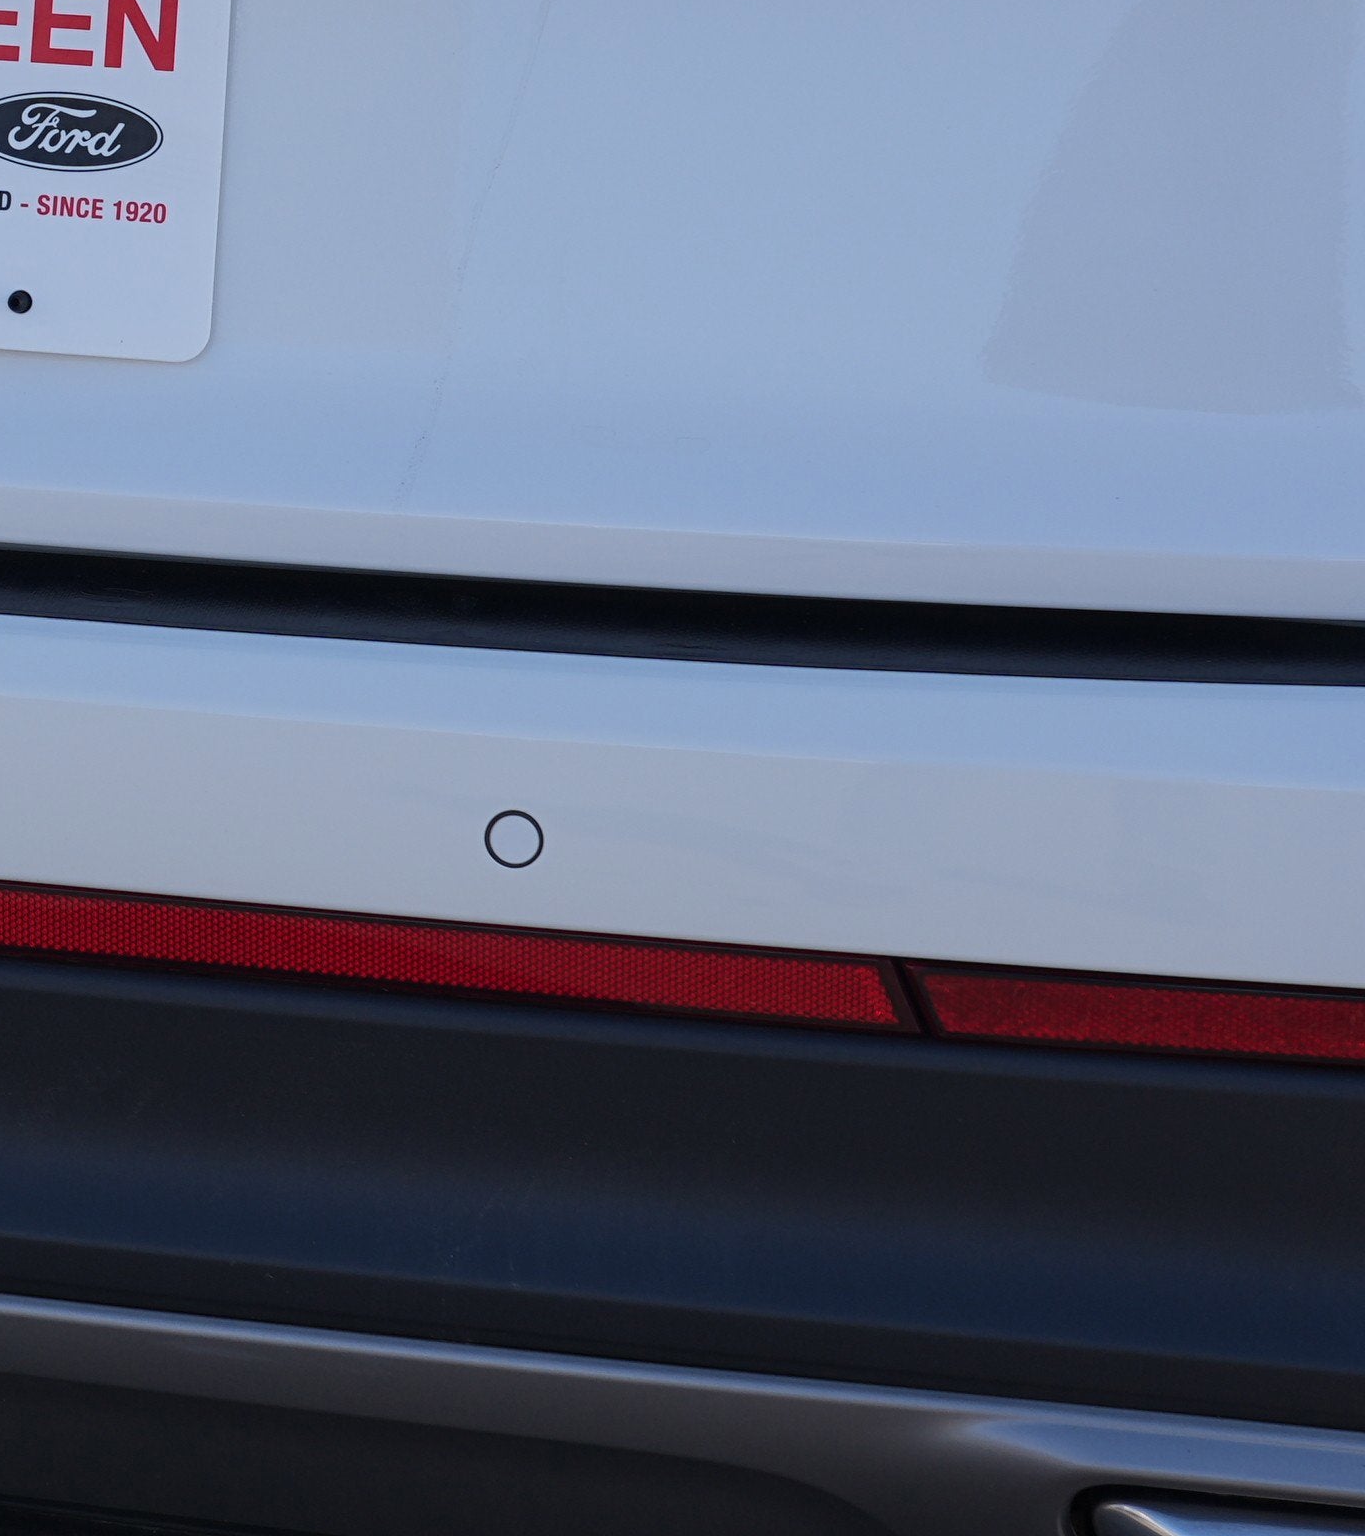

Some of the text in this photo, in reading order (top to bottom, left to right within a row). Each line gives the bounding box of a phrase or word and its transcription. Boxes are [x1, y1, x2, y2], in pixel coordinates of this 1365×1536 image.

[7, 102, 126, 158] Ford
[36, 194, 104, 220] SINCE
[112, 200, 167, 224] 1920
